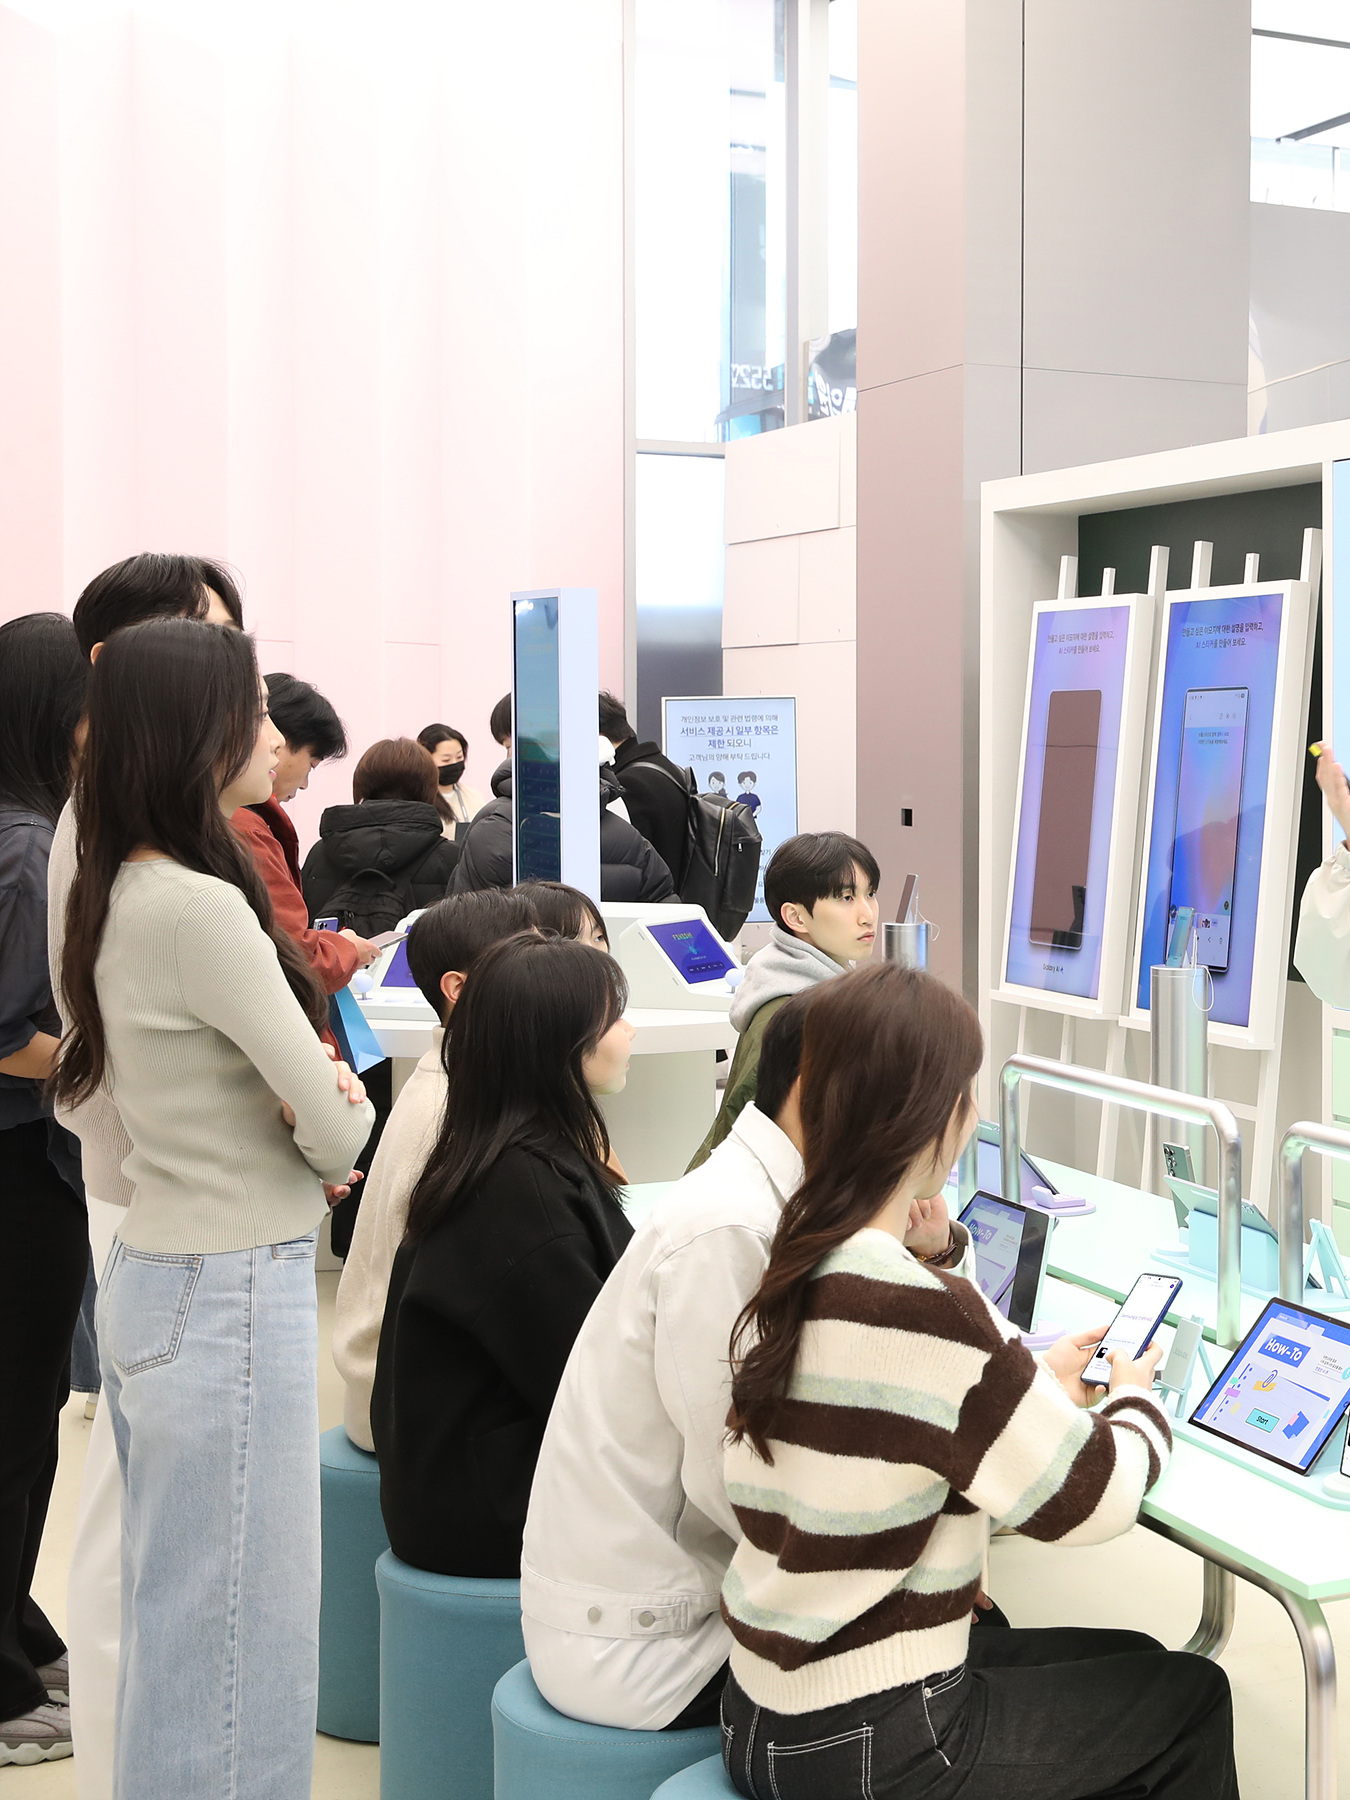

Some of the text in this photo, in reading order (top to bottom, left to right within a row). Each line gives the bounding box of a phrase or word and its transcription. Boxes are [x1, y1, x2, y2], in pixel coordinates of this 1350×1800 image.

[765, 714, 778, 722] 의해
[680, 726, 779, 736] 서비스 제공 시 일부 항목은
[708, 738, 752, 748] 제한 되오니
[1264, 1338, 1302, 1361] HOW-TO
[1256, 1416, 1268, 1425] Start
